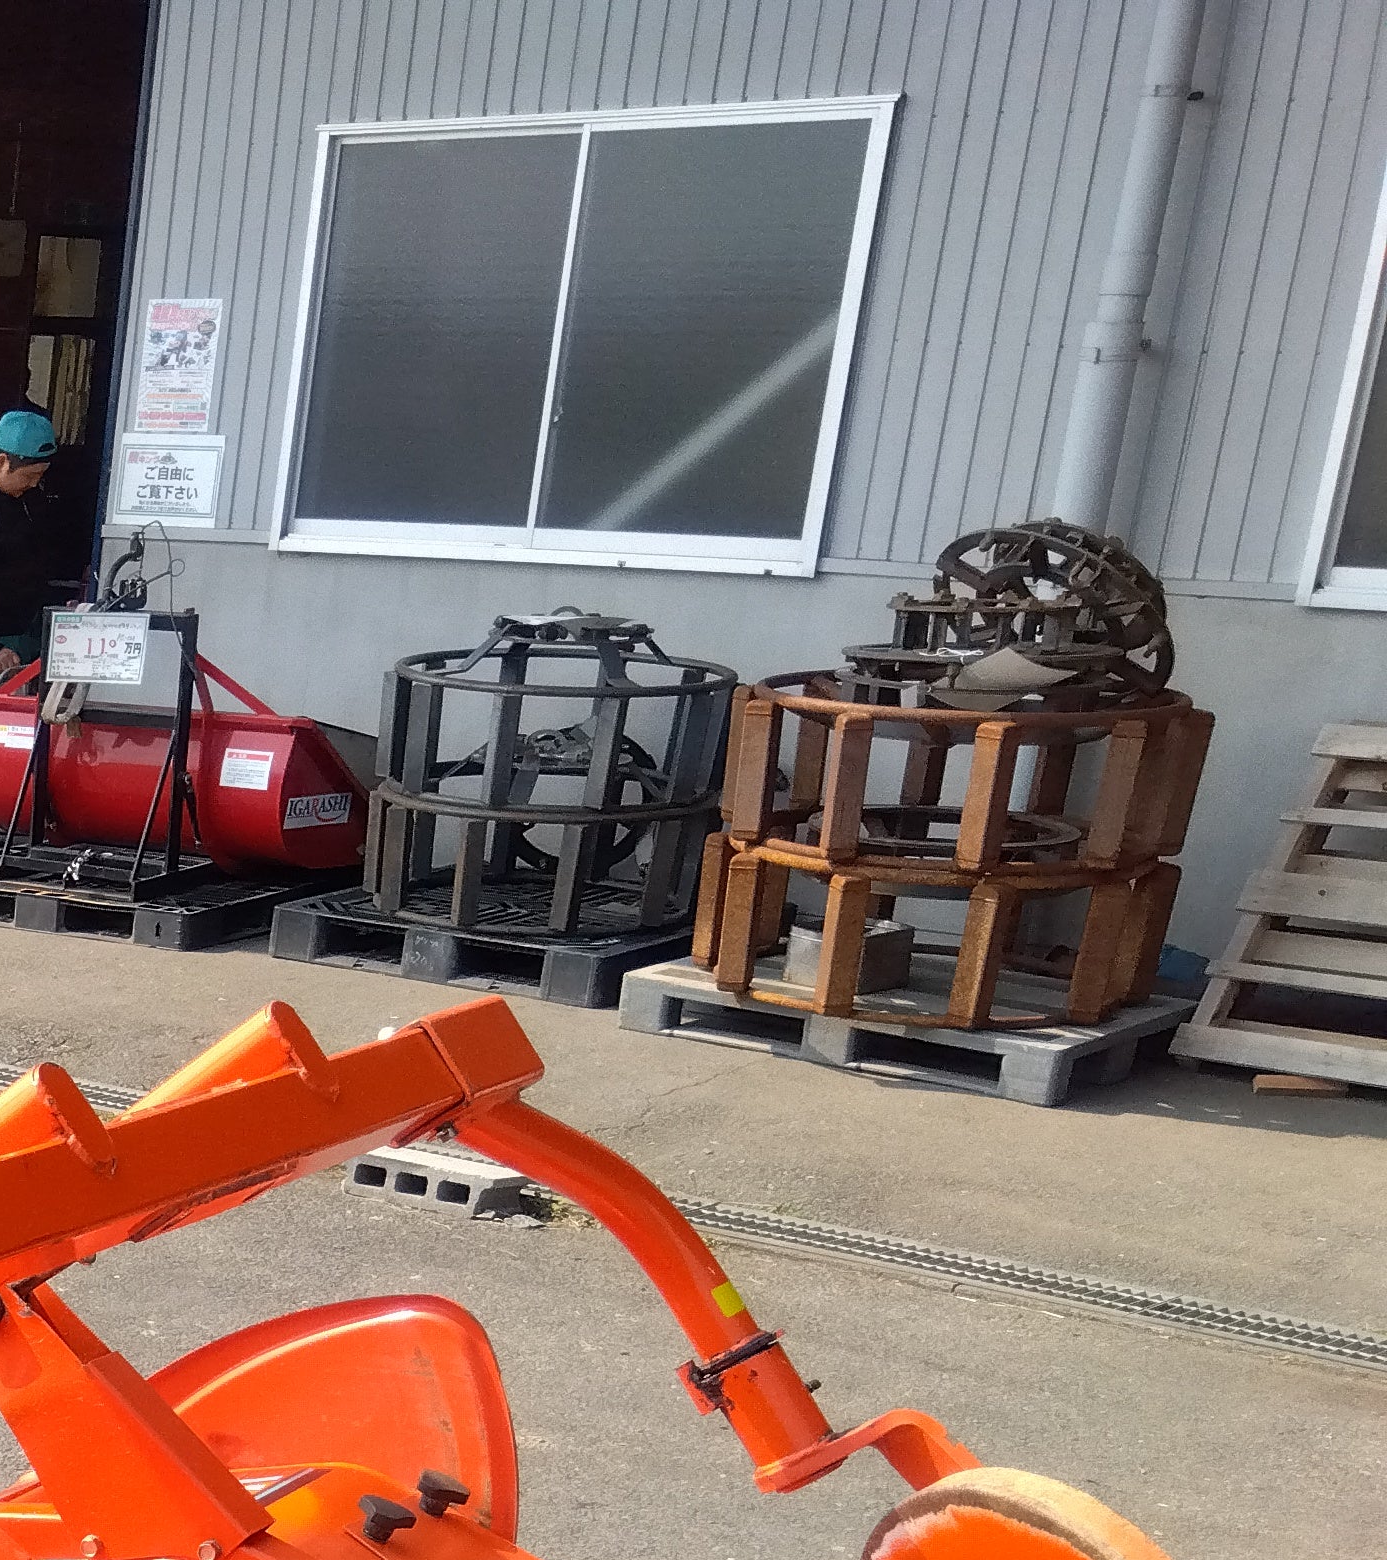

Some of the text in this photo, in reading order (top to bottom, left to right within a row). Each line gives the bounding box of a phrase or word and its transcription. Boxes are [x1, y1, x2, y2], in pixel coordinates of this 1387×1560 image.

[144, 465, 195, 481] ご自由に
[136, 484, 198, 500] ご覧下さい
[123, 642, 142, 655] 万円
[287, 794, 351, 820] IGARASHI
